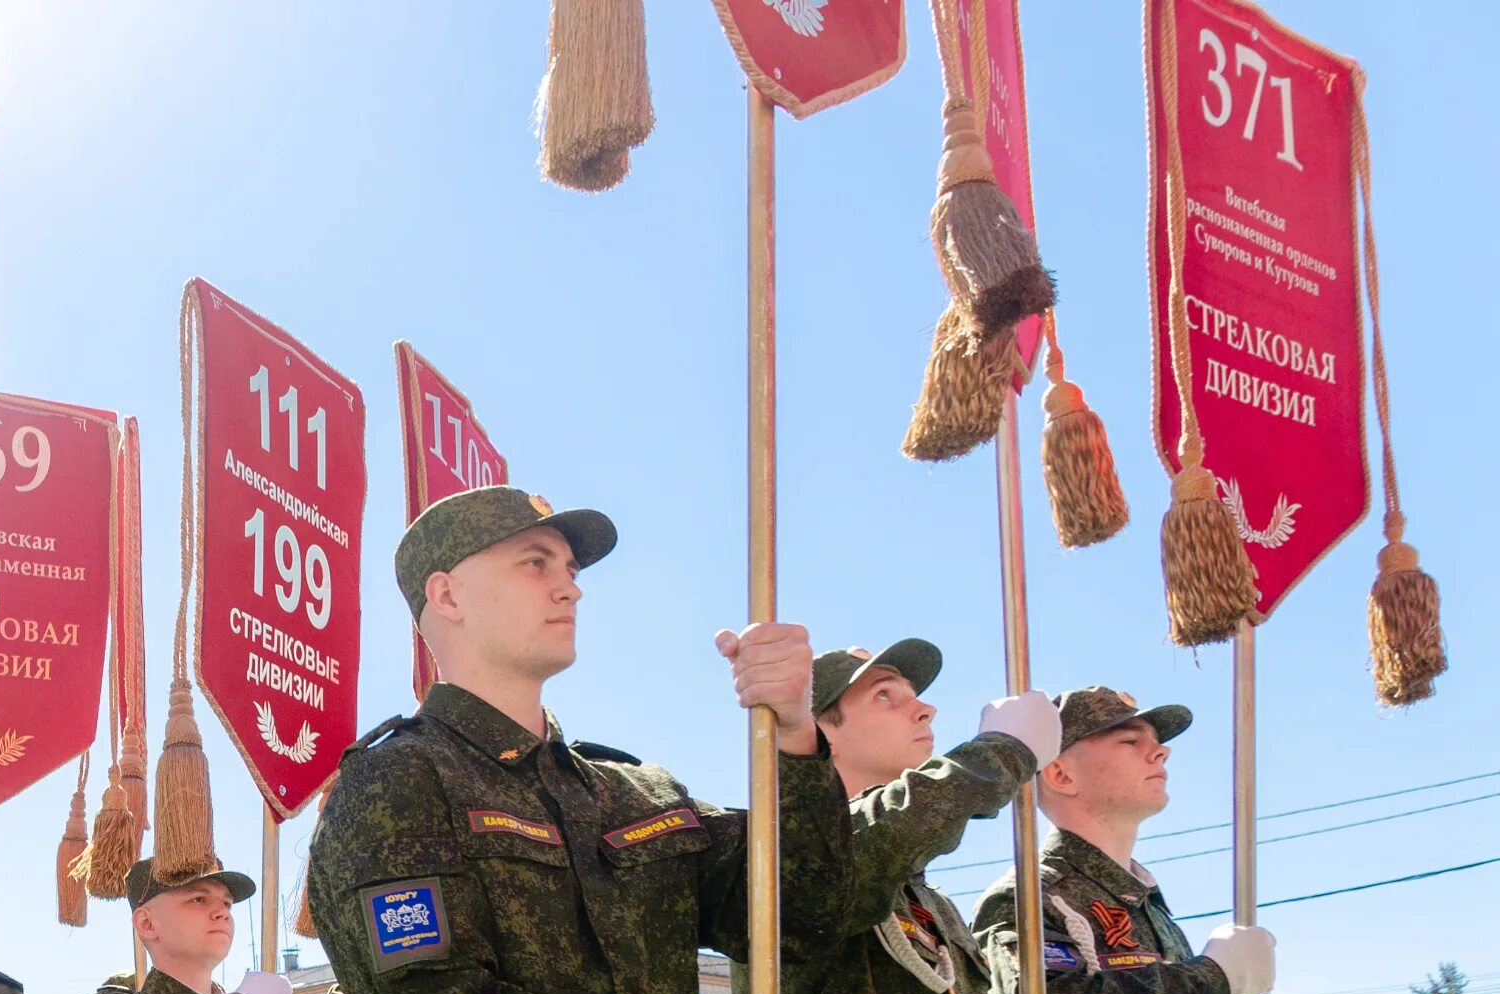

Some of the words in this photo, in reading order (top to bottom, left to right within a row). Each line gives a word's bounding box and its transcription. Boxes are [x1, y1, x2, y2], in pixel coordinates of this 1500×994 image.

[1199, 28, 1304, 172] 371
[1186, 197, 1284, 256] раснознаменная
[1286, 246, 1337, 281] орденов
[1225, 185, 1286, 233] Витебская
[1194, 223, 1252, 265] Суворова
[1254, 256, 1263, 271] и
[1265, 256, 1320, 297] Кутузова
[1185, 294, 1337, 386] СТРЕЛКОВАЯ
[249, 364, 327, 490] 111
[1204, 358, 1316, 428] ДИВИЗИЯ
[224, 448, 349, 550] Александрийская
[244, 507, 332, 630] 199
[229, 606, 340, 685] СТРЕЛКОВЫЕ
[246, 651, 325, 712] ДИВИЗИИ
